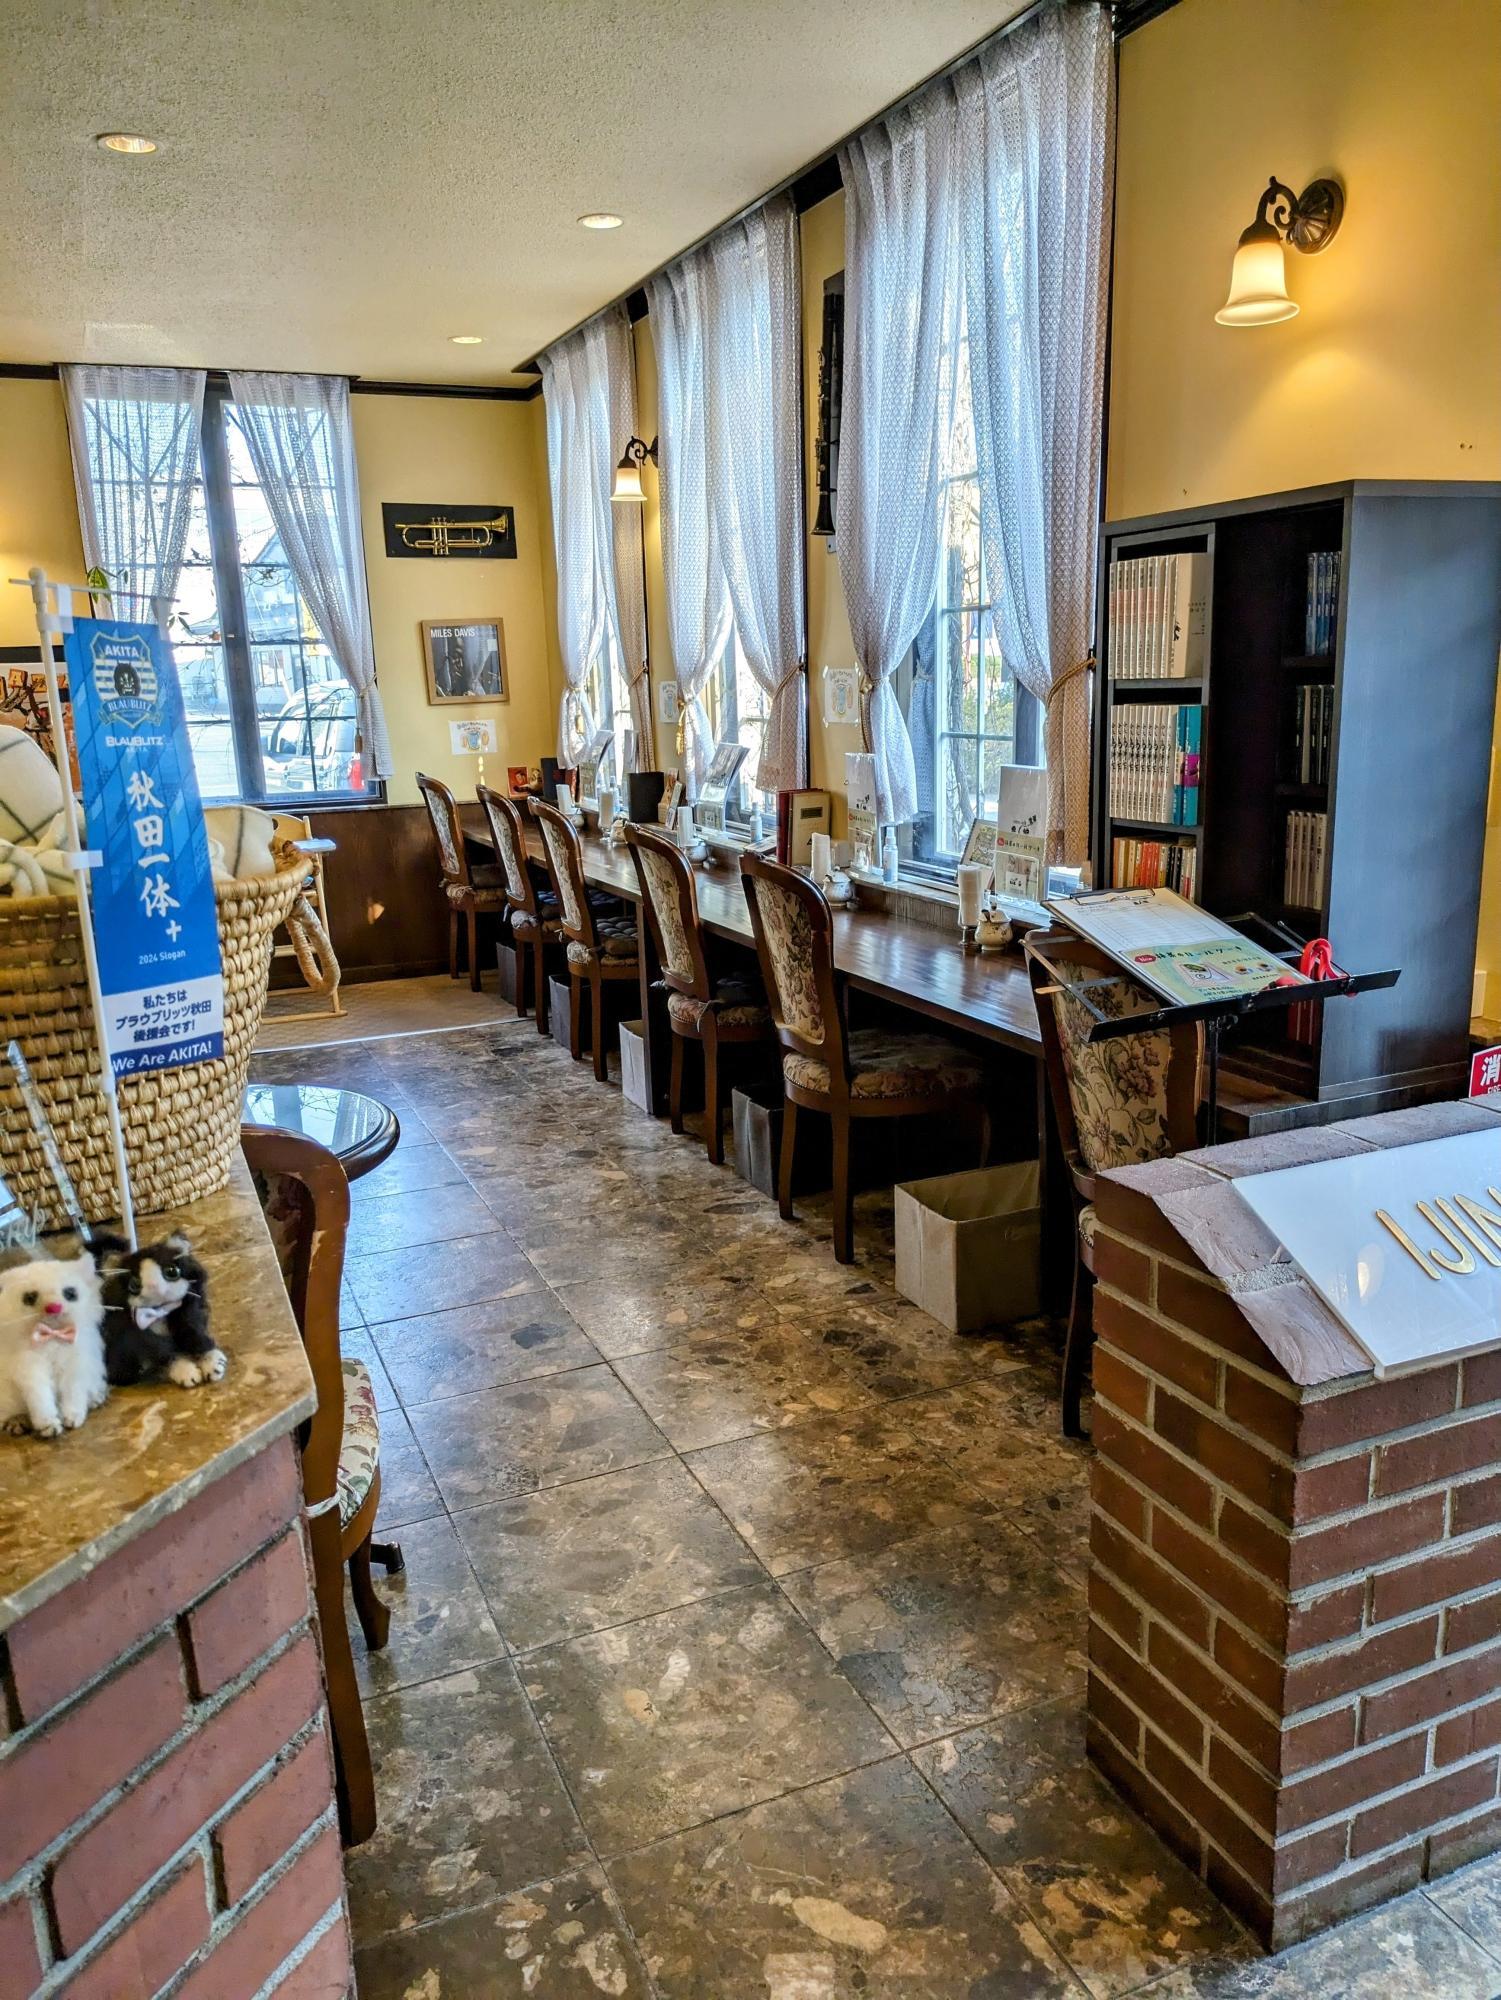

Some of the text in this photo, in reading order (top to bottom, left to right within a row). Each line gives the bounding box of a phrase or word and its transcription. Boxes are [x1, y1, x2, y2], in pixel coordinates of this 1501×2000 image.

[431, 628, 475, 638] MILES DAVIS
[105, 645, 139, 657] AKITA
[105, 736, 163, 747] BLAUBLITZ
[139, 950, 186, 964] 2024 Slogan
[143, 990, 188, 1009] 私たちは
[116, 1000, 212, 1030] ブラウブリッツ秋田
[113, 1041, 212, 1072] We Are AKITA!
